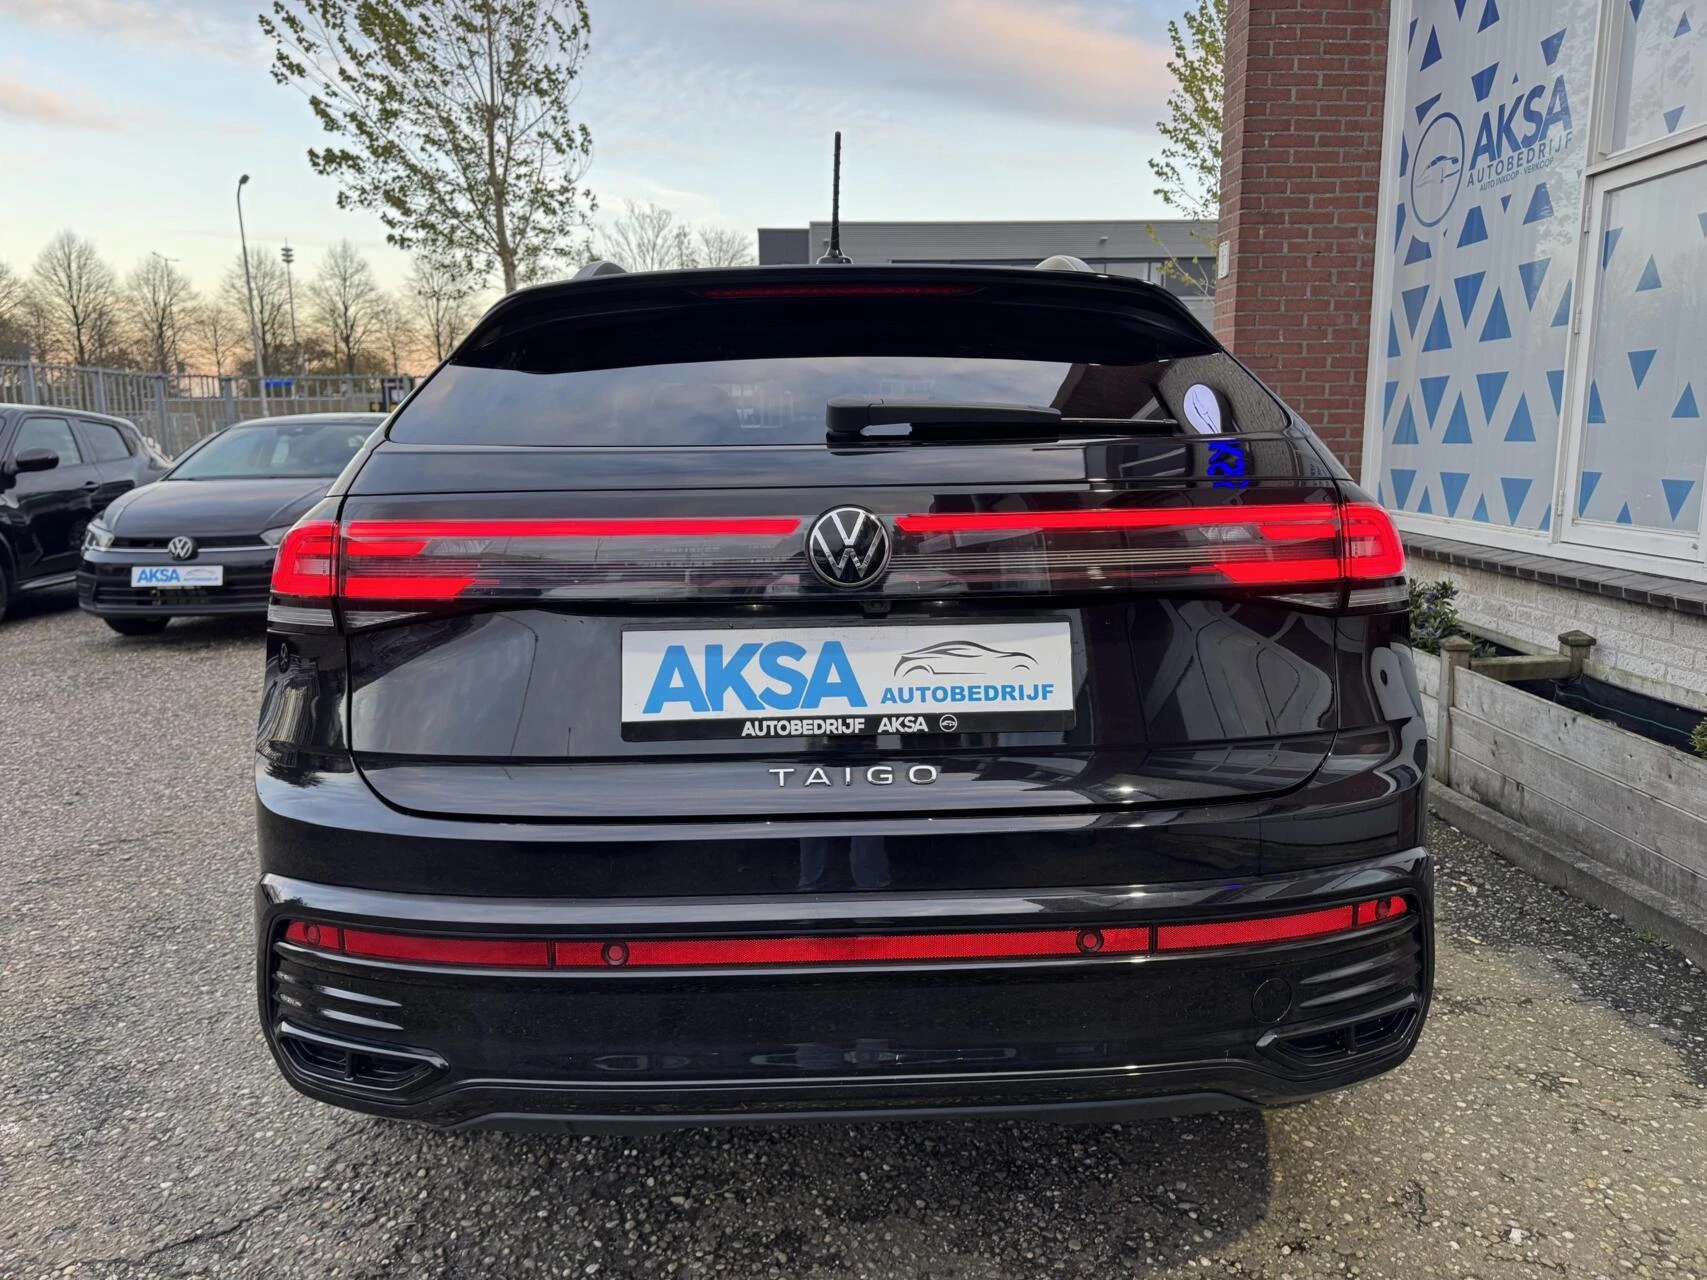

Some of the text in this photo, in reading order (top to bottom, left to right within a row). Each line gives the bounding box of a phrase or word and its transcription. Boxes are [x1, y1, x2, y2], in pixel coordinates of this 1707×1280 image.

[1468, 75, 1573, 171] AKSA
[1466, 131, 1573, 188] AUTOBEDRIJF
[137, 568, 180, 583] AKSA
[642, 640, 868, 715] AKSA
[881, 683, 1055, 705] AUTOBEDRIJF
[742, 717, 928, 737] AUTOBEDRIJF AKSA
[769, 764, 938, 787] TAIGO
